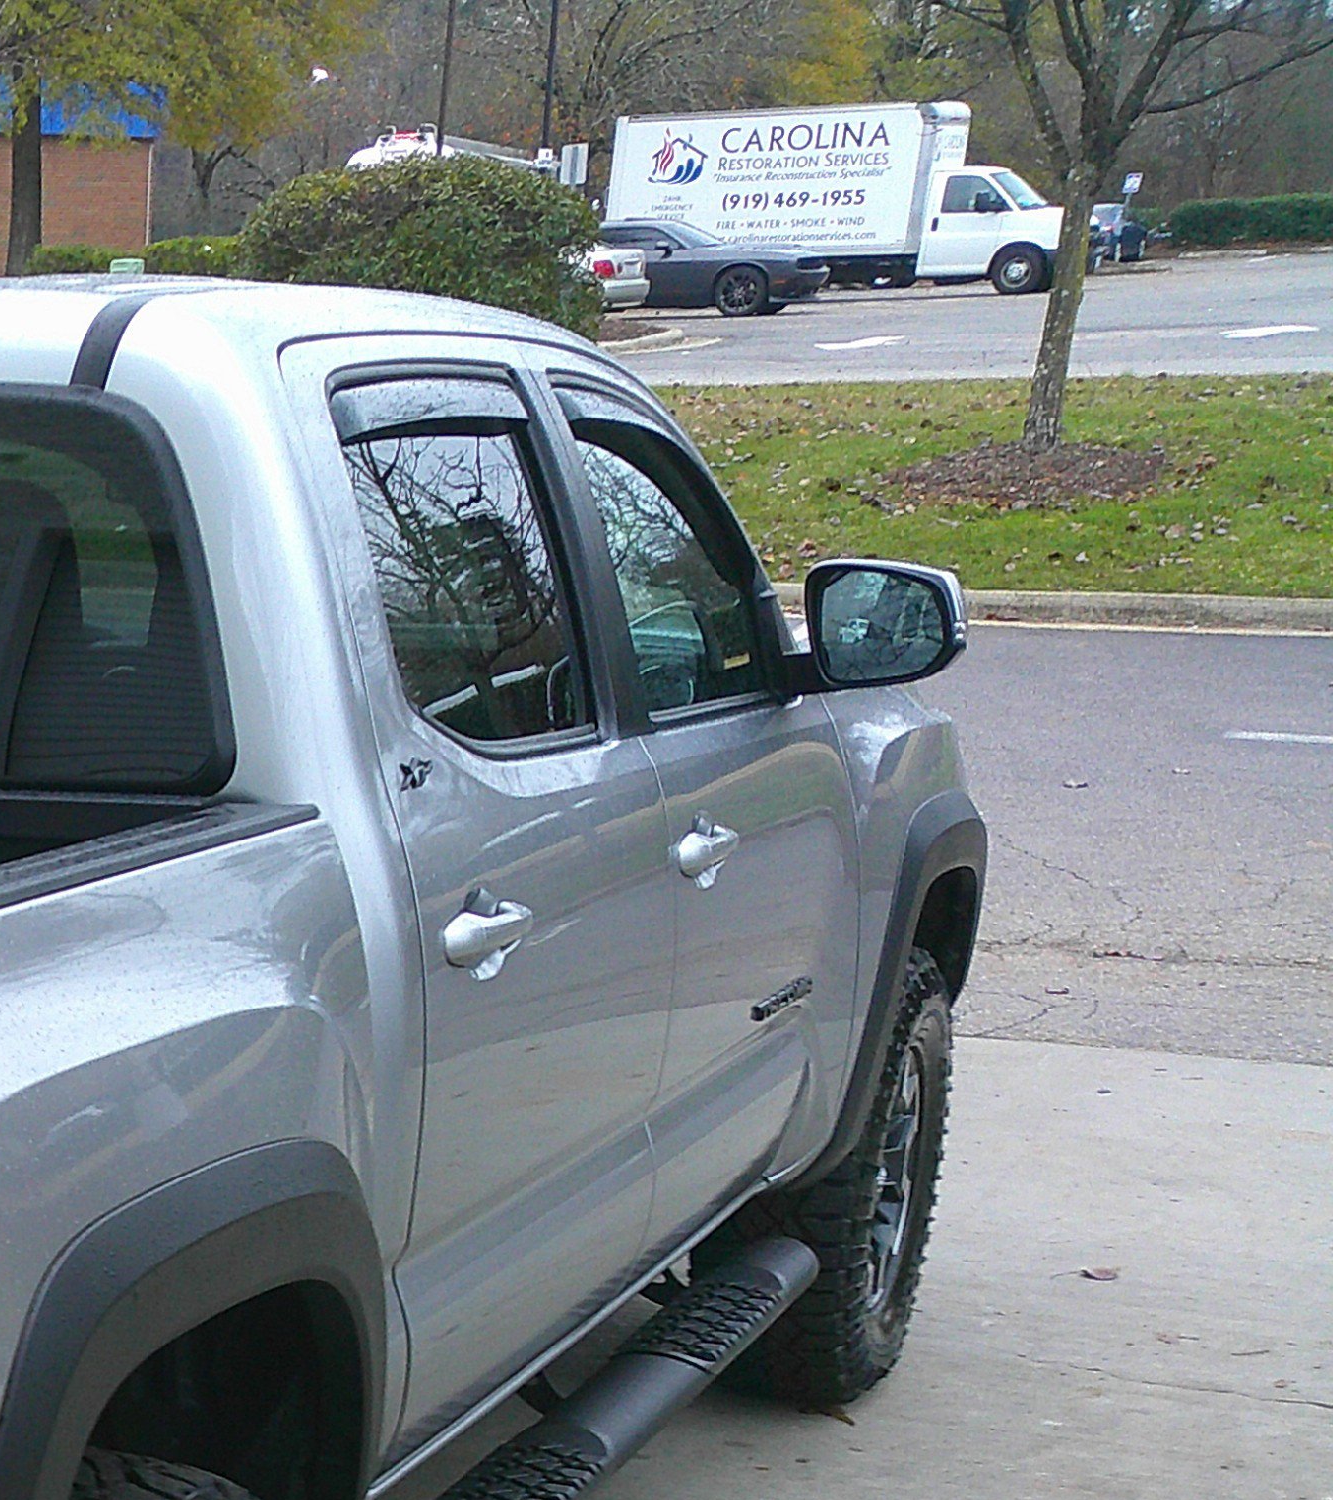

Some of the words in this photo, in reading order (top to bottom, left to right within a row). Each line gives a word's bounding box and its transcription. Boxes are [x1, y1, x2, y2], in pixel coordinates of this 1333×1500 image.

[721, 121, 890, 154] CAROLINA
[717, 154, 819, 171] RESTORATION
[824, 152, 890, 167] SERVICES
[764, 169, 837, 181] Reconstruction
[722, 192, 769, 212] (919)
[773, 188, 866, 208] 469-1955
[716, 220, 736, 230] FIRE
[746, 218, 780, 229] WATER
[789, 217, 826, 228] SMOKE
[837, 216, 865, 226] WIND
